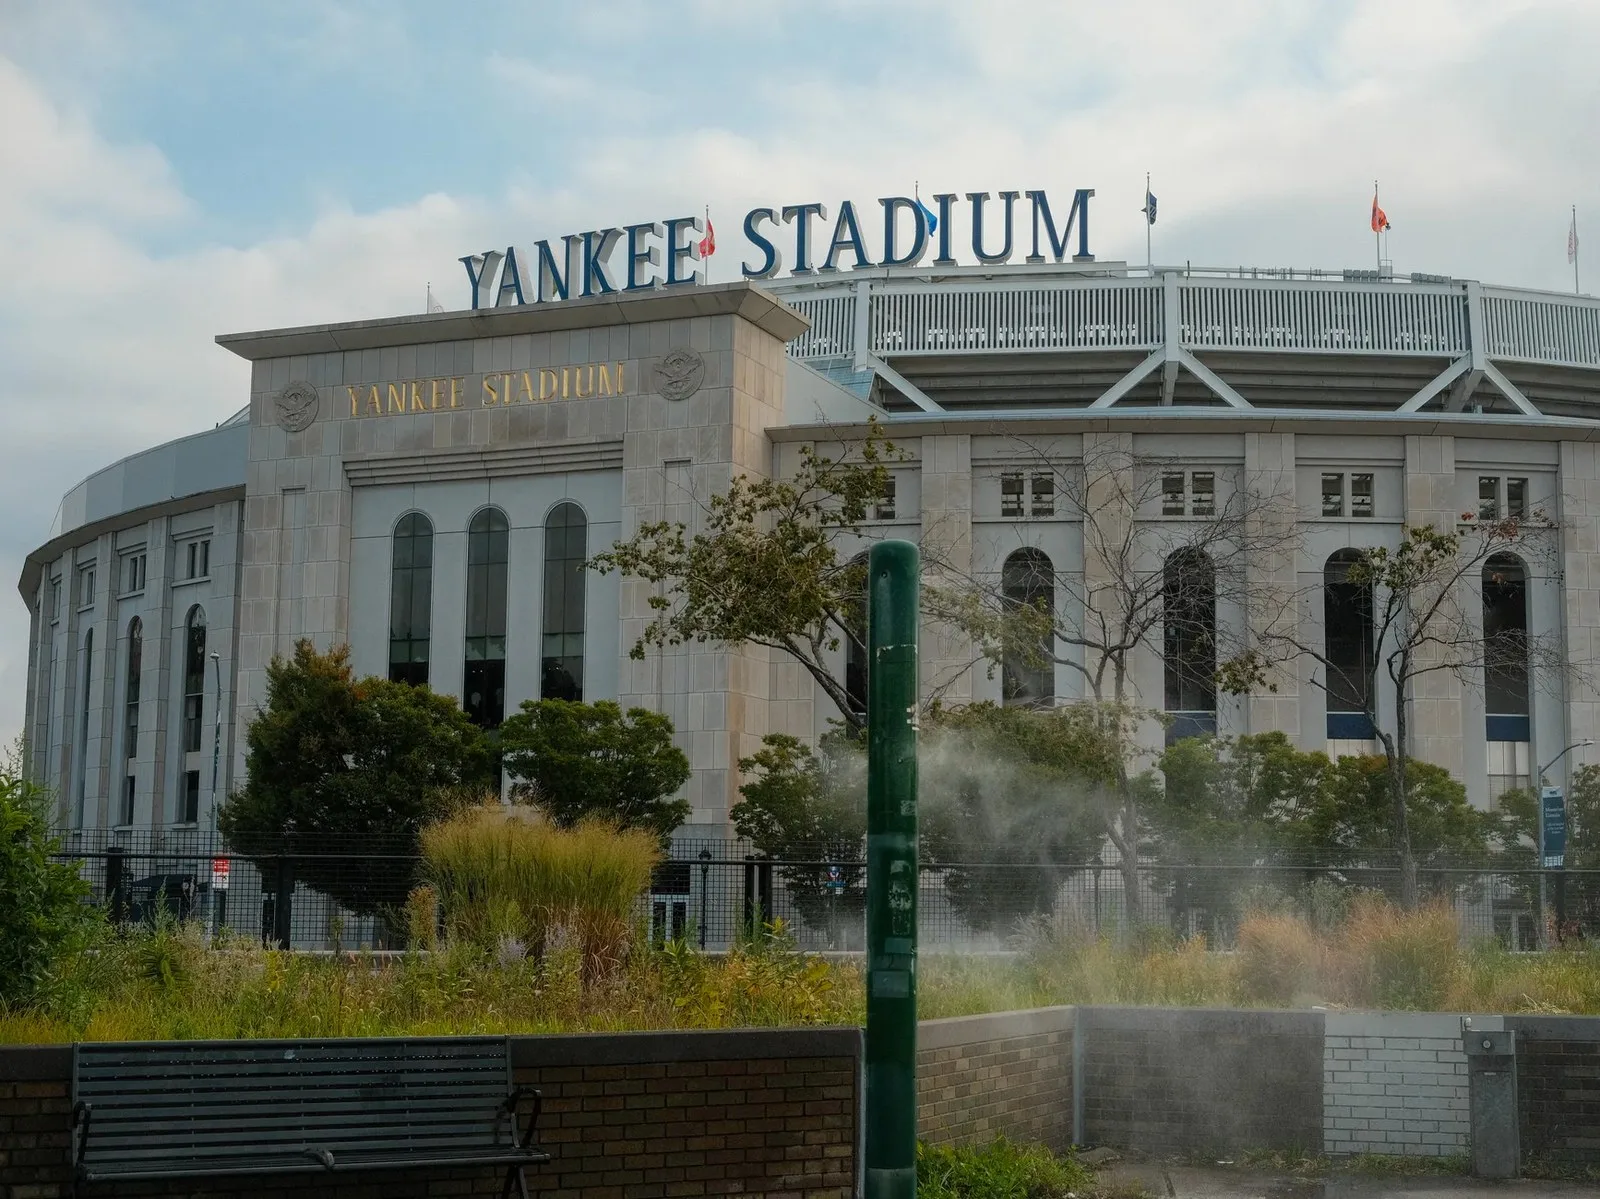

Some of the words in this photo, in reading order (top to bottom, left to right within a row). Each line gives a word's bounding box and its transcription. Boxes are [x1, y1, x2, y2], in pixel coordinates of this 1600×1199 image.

[458, 216, 703, 310] YANKEE
[742, 189, 1095, 280] STADIUM
[347, 377, 465, 417] YANKEE
[482, 361, 626, 407] STADIUM
